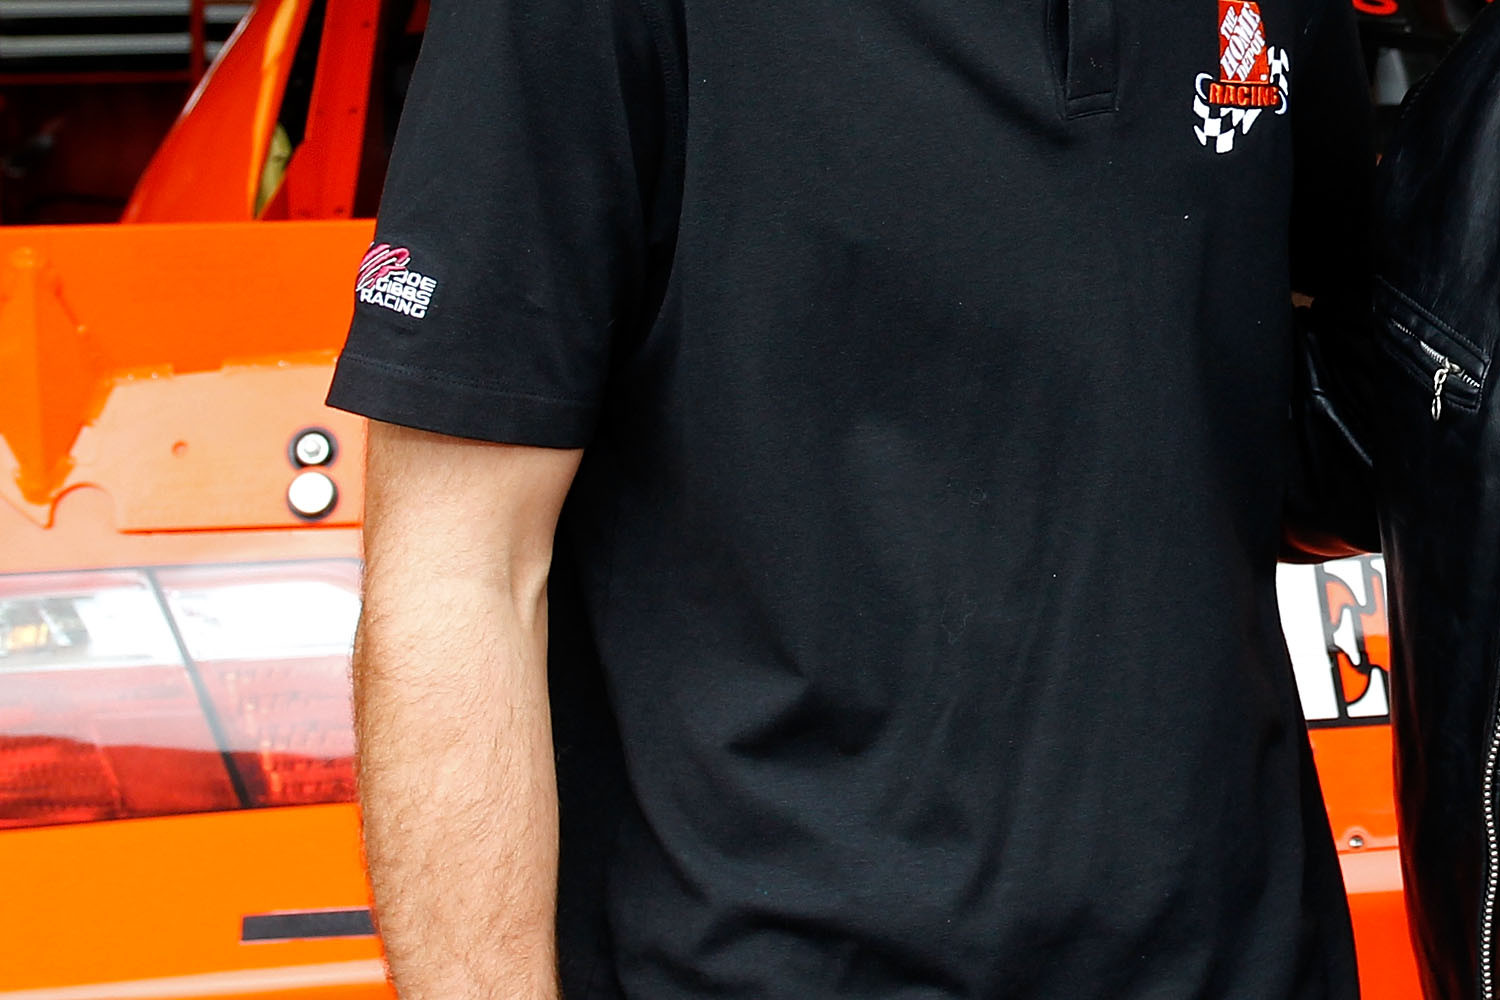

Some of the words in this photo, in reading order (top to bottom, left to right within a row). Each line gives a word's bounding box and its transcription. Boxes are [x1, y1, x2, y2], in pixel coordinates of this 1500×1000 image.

[1220, 6, 1239, 41] THE
[1220, 2, 1261, 80] HOME
[1236, 29, 1266, 82] DEPOT
[1208, 82, 1279, 107] RACING
[360, 286, 428, 319] RACING
[375, 278, 432, 306] GIBBS
